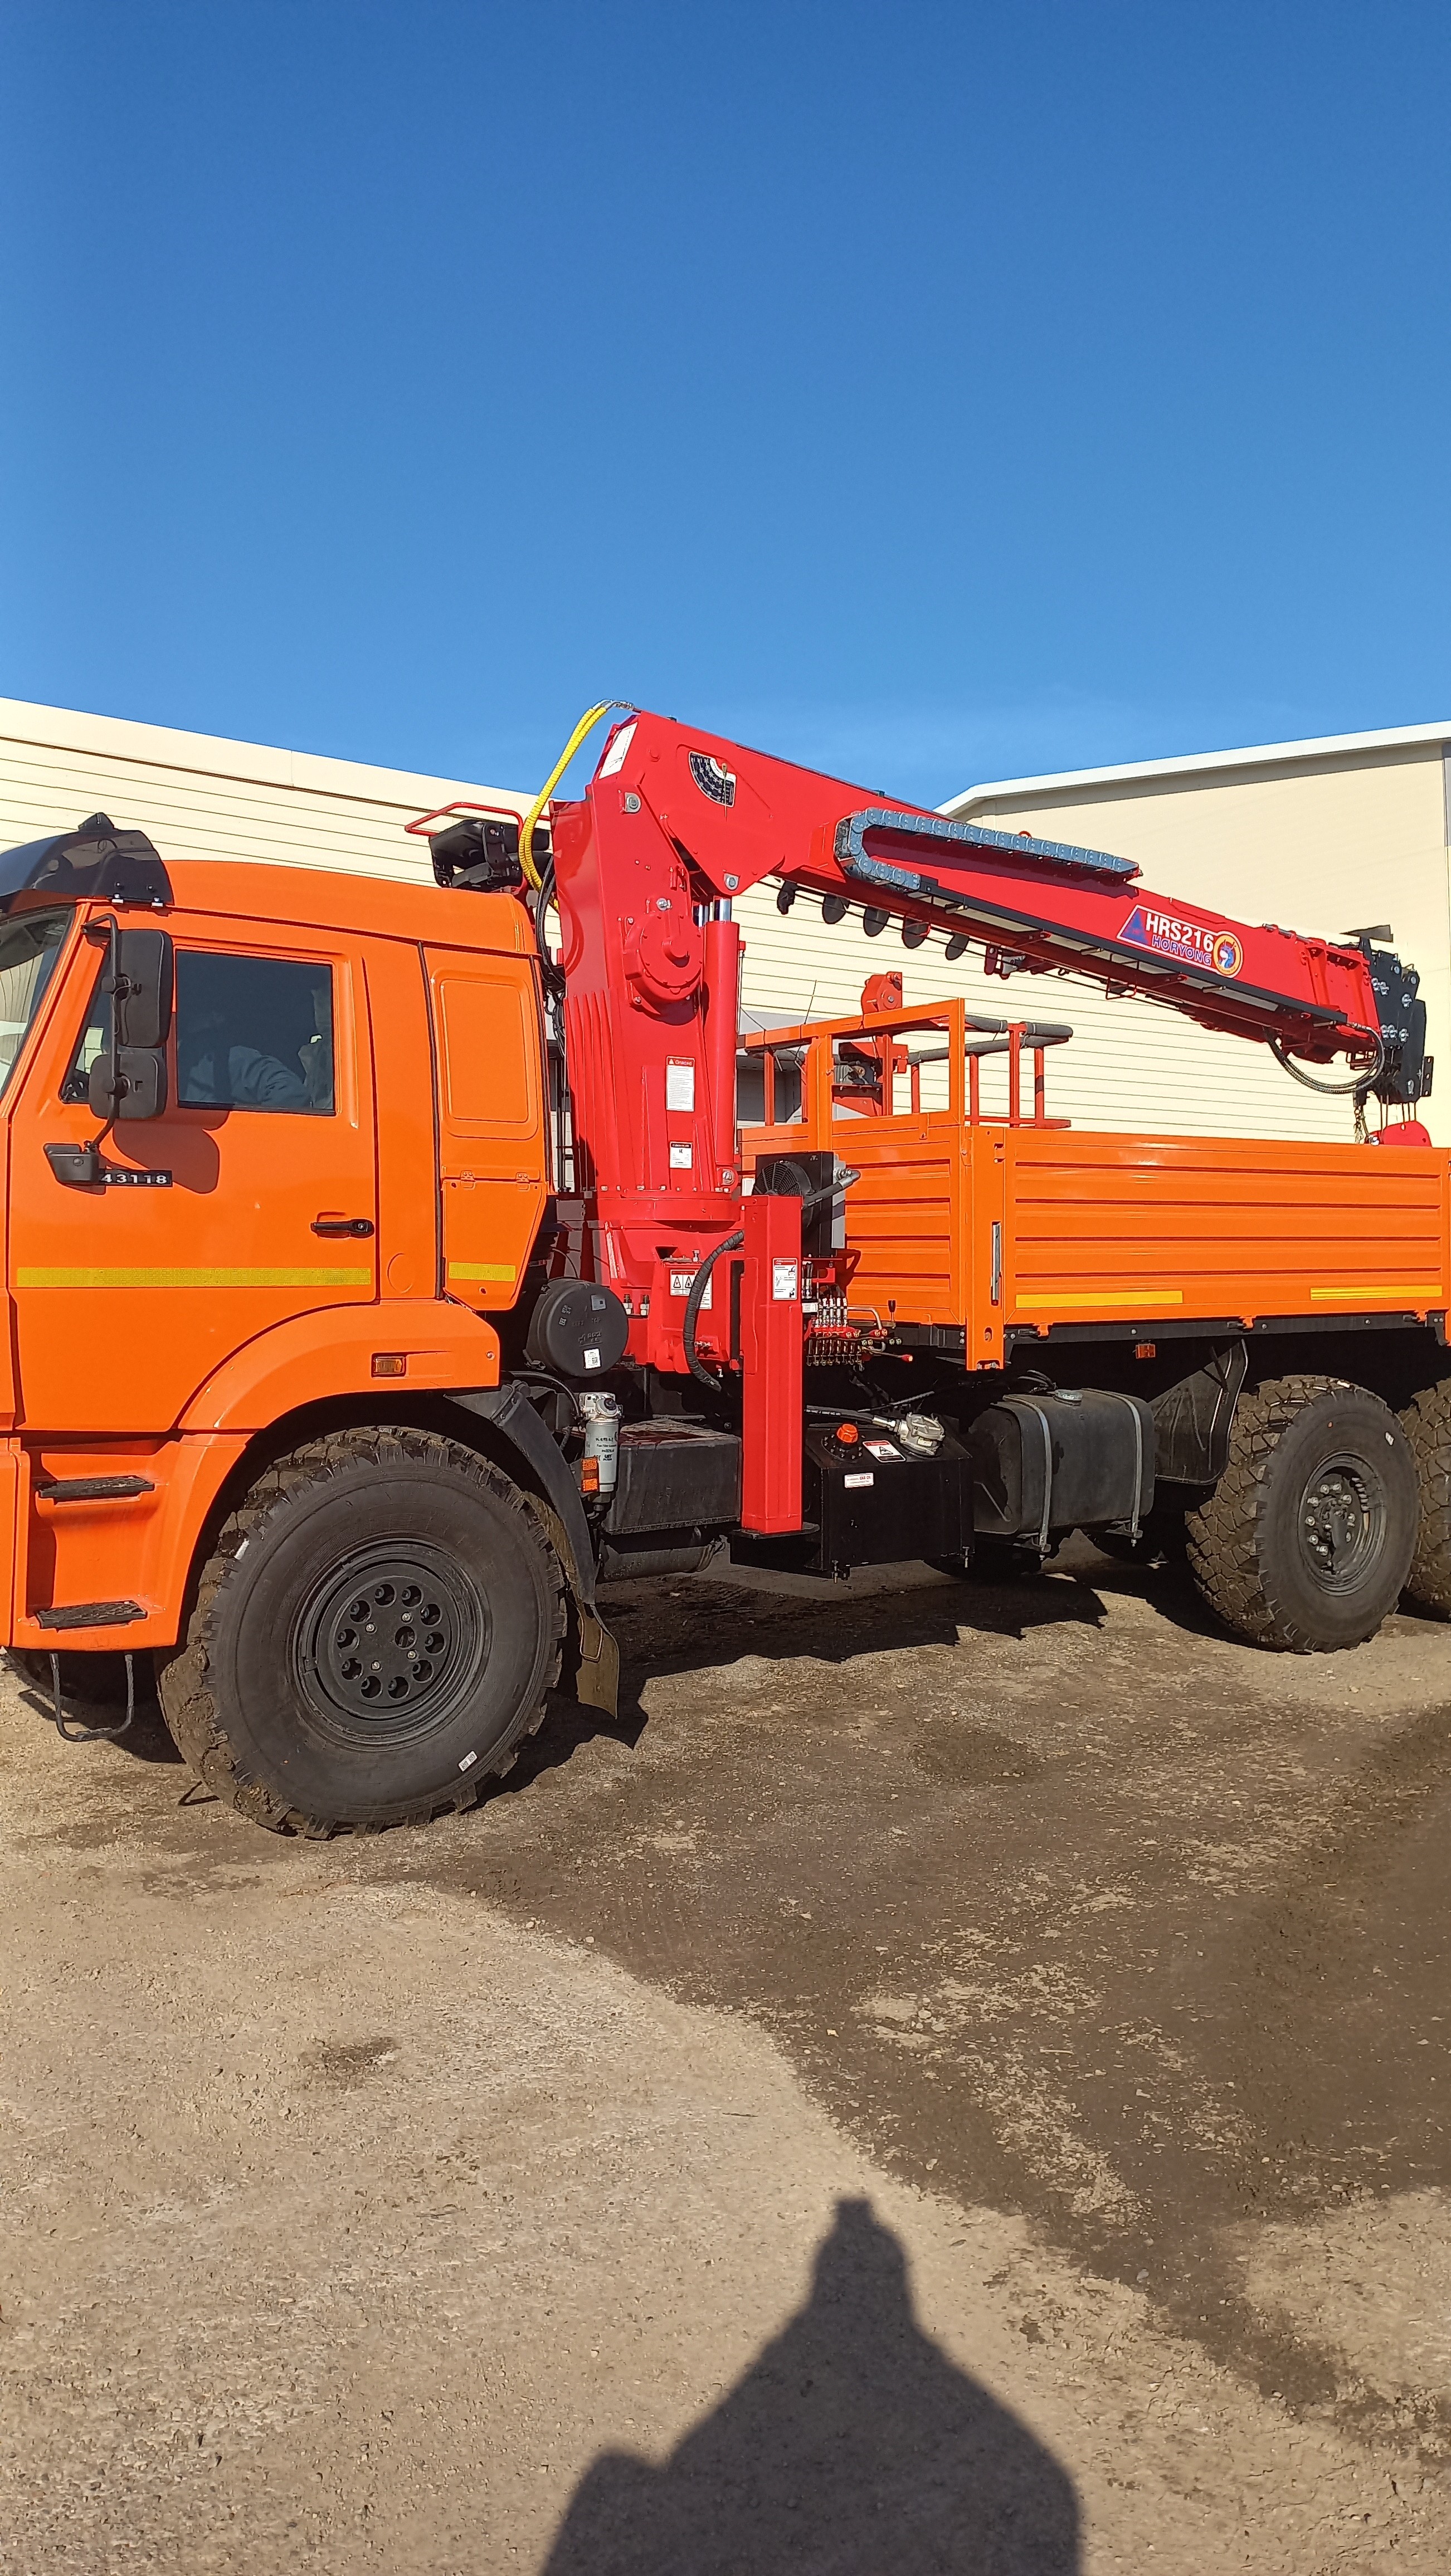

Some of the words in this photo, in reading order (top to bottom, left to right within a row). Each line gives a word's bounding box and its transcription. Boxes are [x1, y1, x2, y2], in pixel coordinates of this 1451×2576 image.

[1145, 912, 1214, 952] HRS216
[1151, 934, 1212, 966] HORYONG
[100, 1174, 167, 1184] 43118
